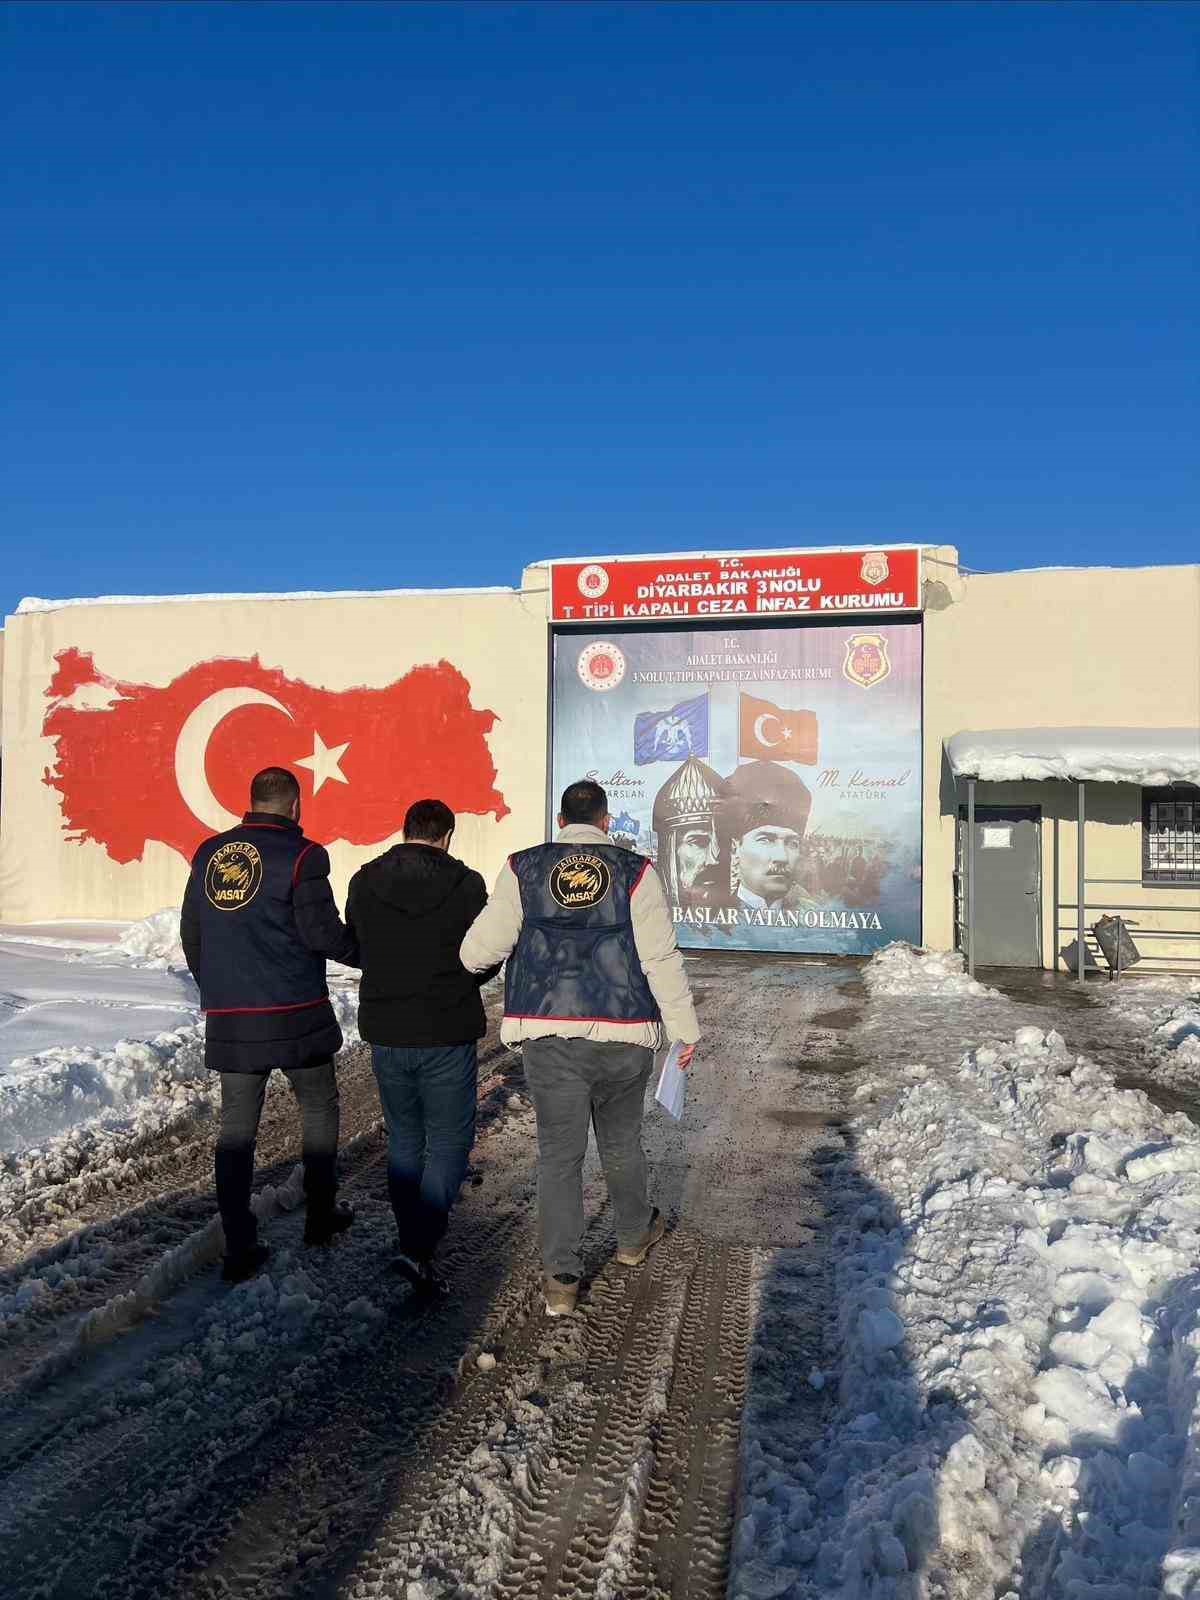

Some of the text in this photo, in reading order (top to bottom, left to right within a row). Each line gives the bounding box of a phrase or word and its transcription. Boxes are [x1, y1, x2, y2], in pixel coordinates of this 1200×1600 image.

[718, 558, 744, 568] T.C.
[655, 567, 801, 583] ADALET BAKANLIĞI
[637, 581, 748, 599] DİYARBAKIR
[563, 592, 904, 618] T TİPİ KAPALI CEZA İNFAZ KURUMU
[724, 638, 740, 649] T.C.
[686, 650, 777, 666] ADALET BAKANLIĞI
[585, 769, 645, 786] Sultan
[848, 768, 912, 788] Kemal
[840, 789, 887, 800] ATATÜRK
[213, 844, 259, 865] JANDARMA
[557, 855, 602, 871] JANDARMA
[215, 889, 246, 901] JASAT
[563, 891, 594, 904] JASAT
[672, 906, 883, 930] BAŞLAR VATAN OLMAYA
